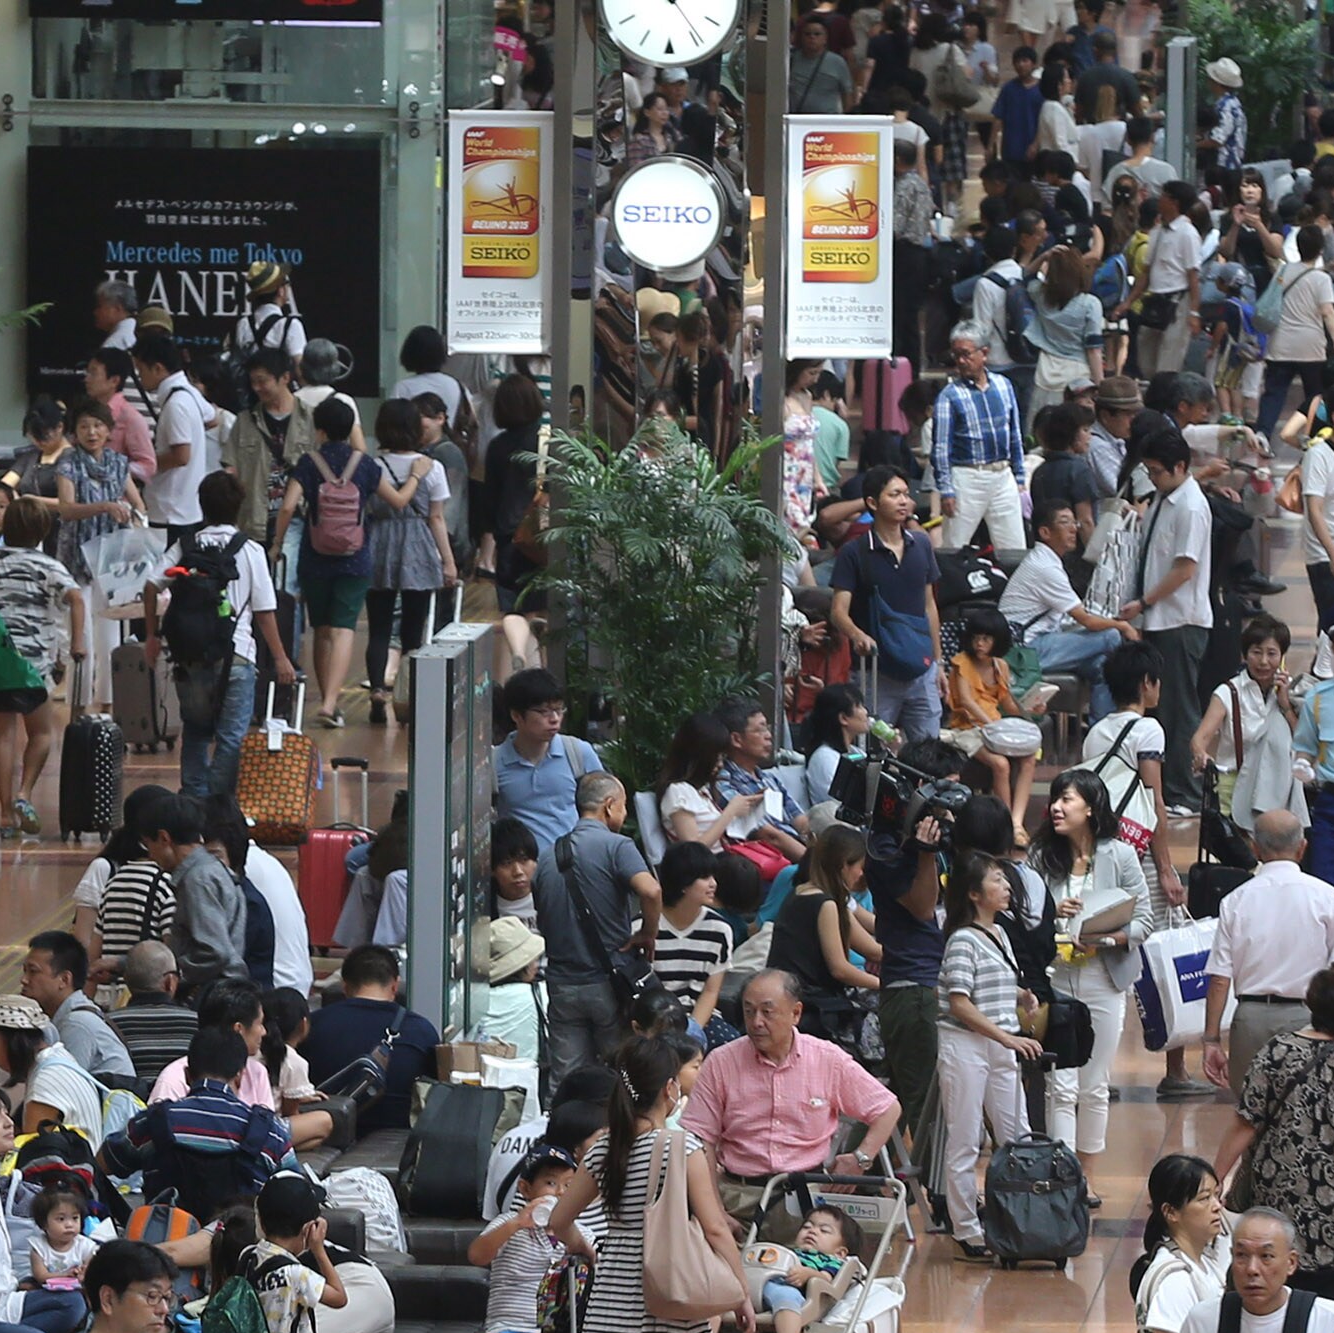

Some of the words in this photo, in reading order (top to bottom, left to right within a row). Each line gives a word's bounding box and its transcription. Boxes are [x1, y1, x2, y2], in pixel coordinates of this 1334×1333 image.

[466, 138, 494, 148] World
[805, 143, 834, 152] World
[466, 147, 537, 159] Championships
[805, 151, 877, 163] Championships
[623, 204, 712, 224] SEIKO
[508, 220, 529, 231] 2015
[848, 225, 870, 235] 2015
[105, 240, 202, 264] Mercedes
[209, 249, 240, 264] me
[244, 242, 304, 266] Tokyo
[470, 246, 531, 261] SEIKO
[810, 251, 871, 266] SEIKO
